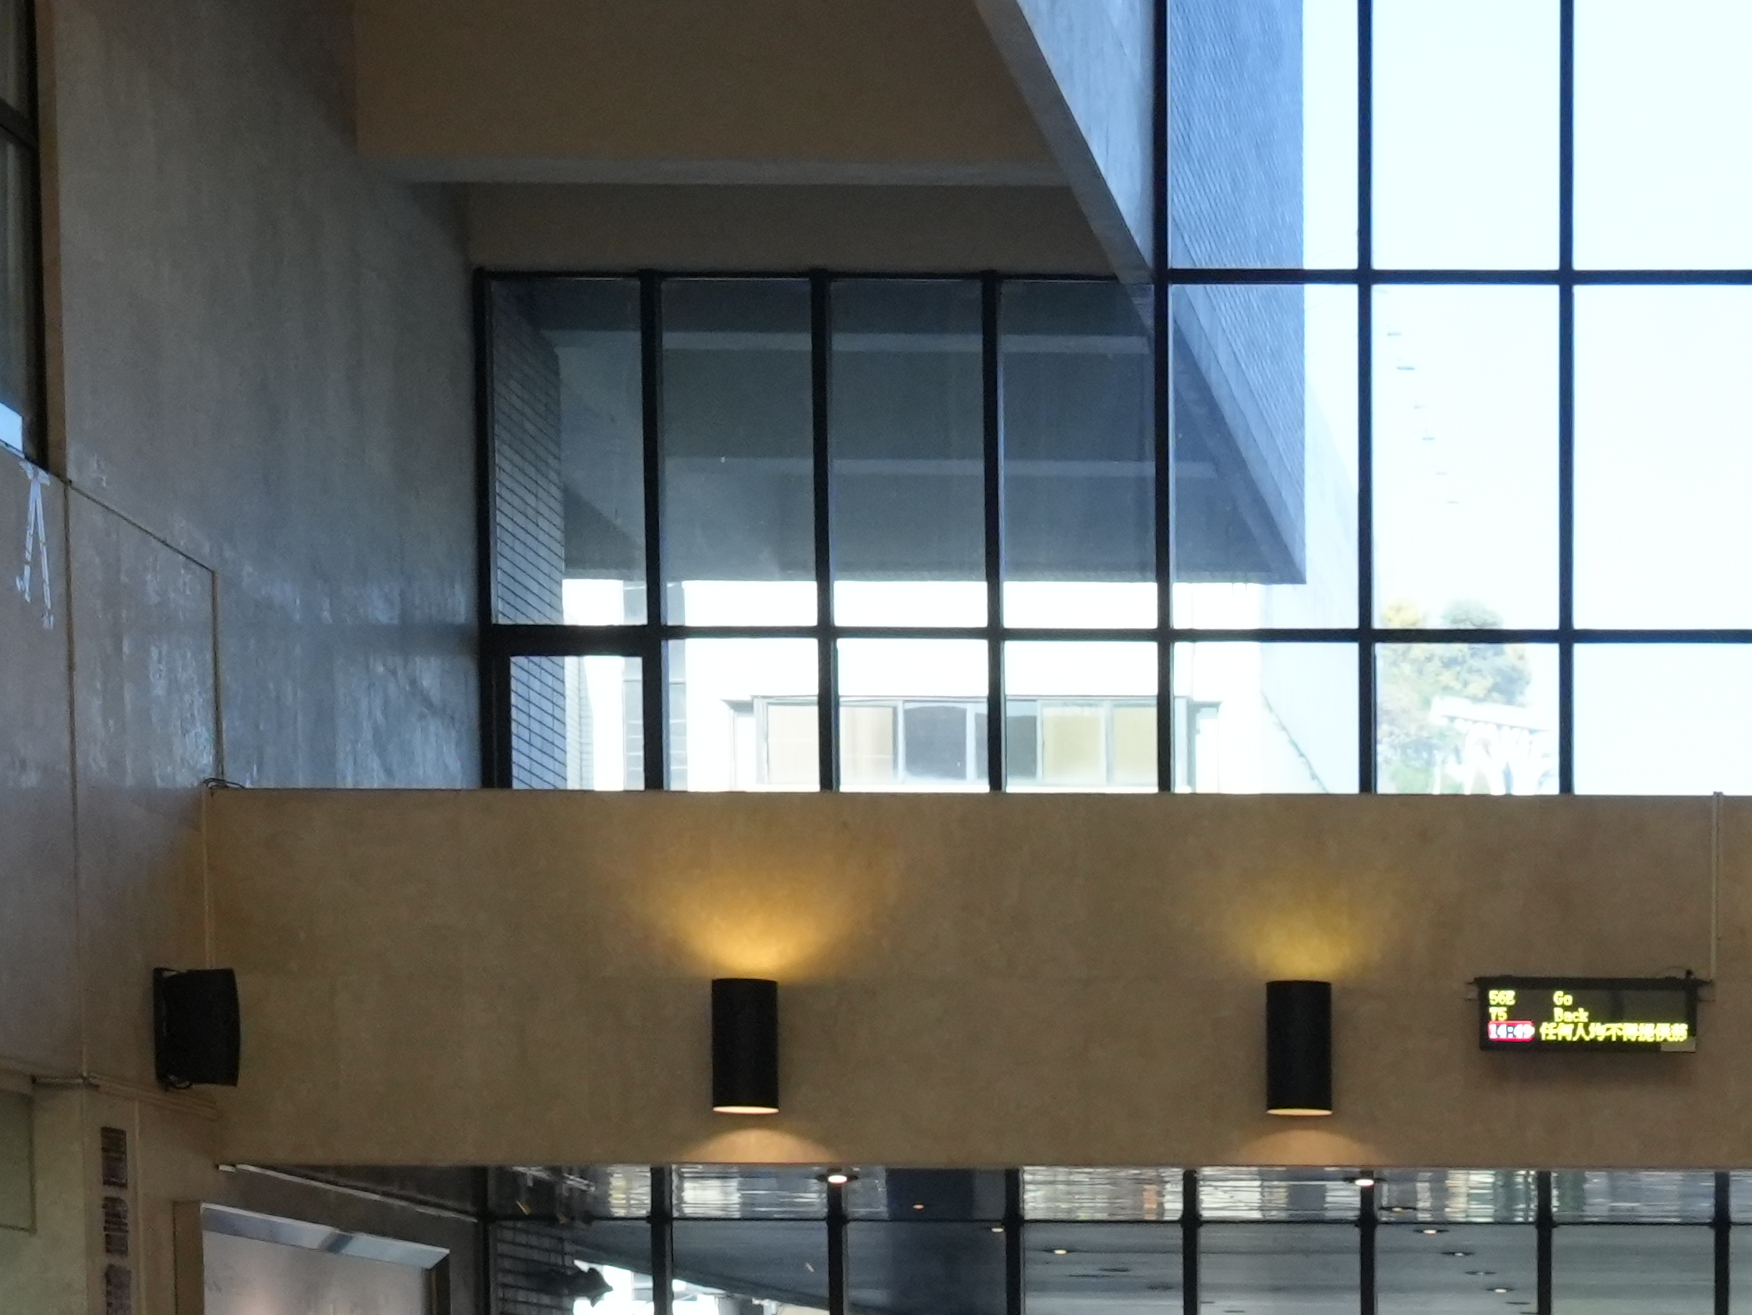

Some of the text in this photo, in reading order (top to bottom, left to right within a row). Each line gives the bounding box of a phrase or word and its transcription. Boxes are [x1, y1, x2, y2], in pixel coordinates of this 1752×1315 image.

[1553, 990, 1573, 1006] Go
[1488, 1006, 1589, 1022] 75 Back
[1488, 1023, 1536, 1040] 14:49
